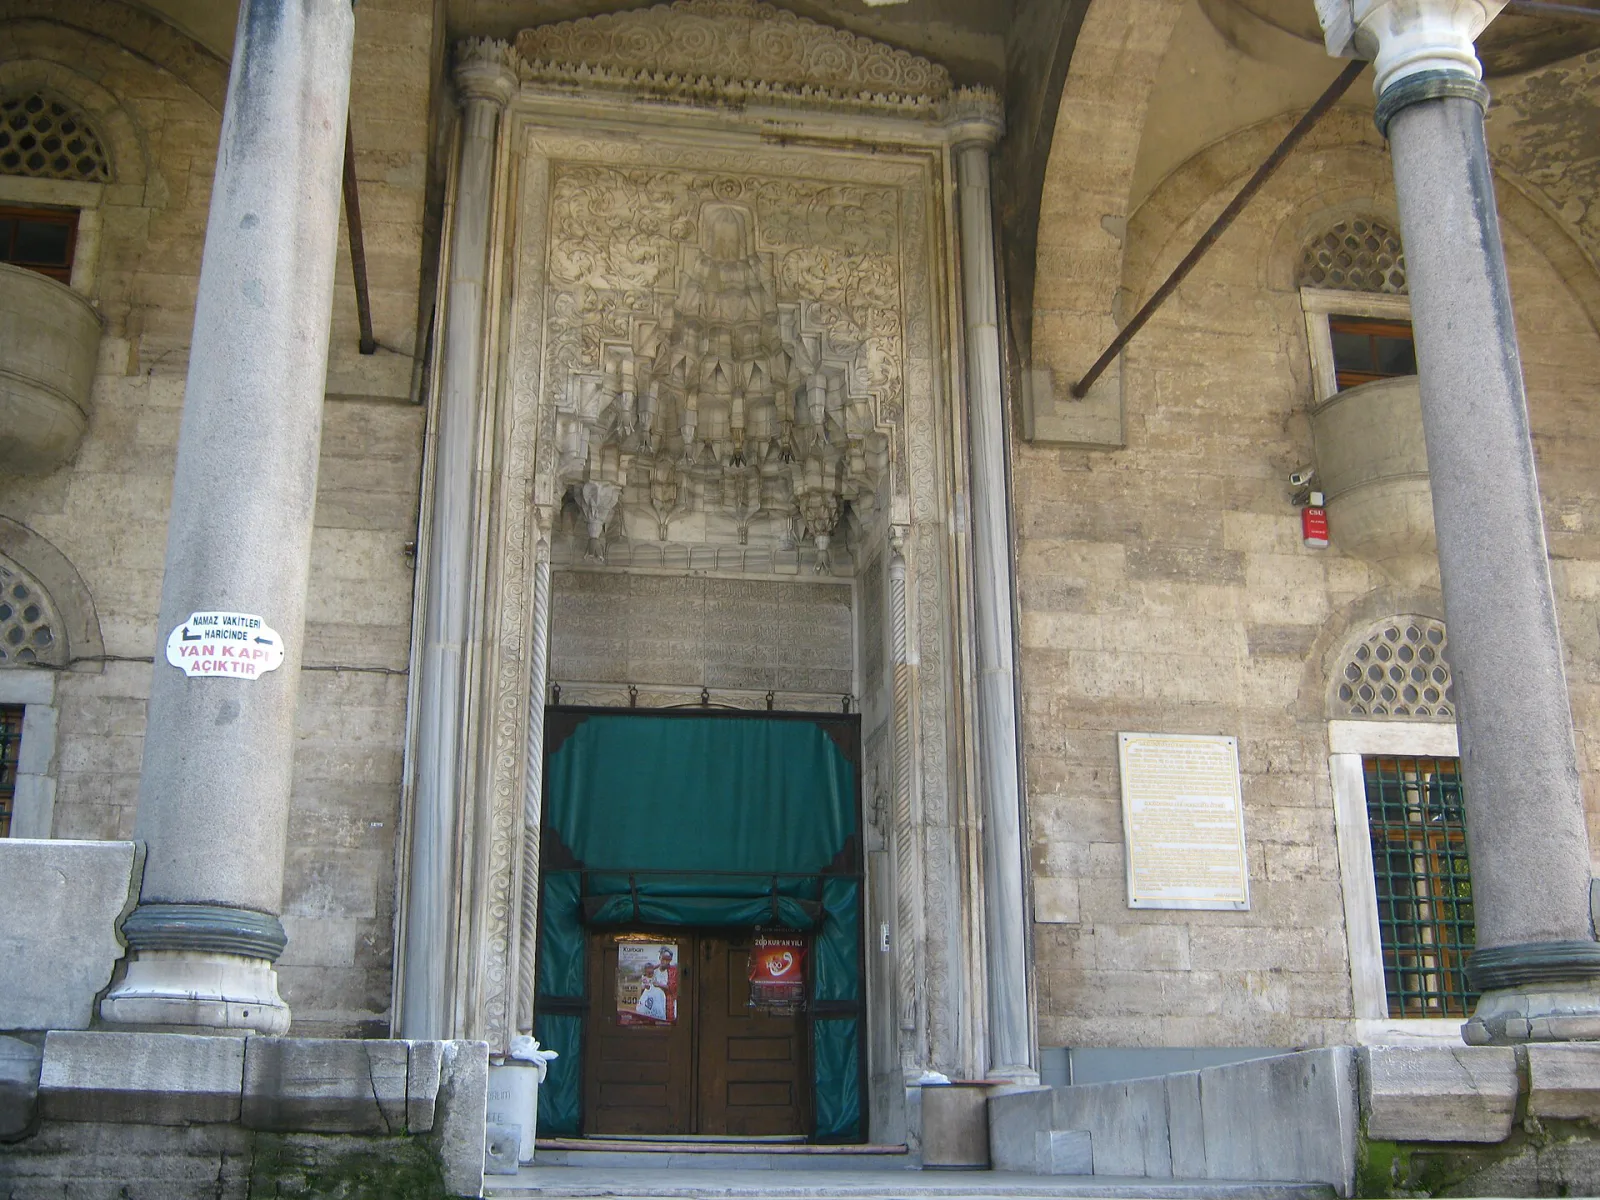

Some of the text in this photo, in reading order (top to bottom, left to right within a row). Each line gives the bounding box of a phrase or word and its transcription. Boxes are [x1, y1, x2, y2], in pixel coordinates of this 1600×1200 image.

[193, 616, 218, 626] NAMAZ
[179, 645, 269, 662] YAN KAPI
[191, 660, 256, 674] AÇIKTIR
